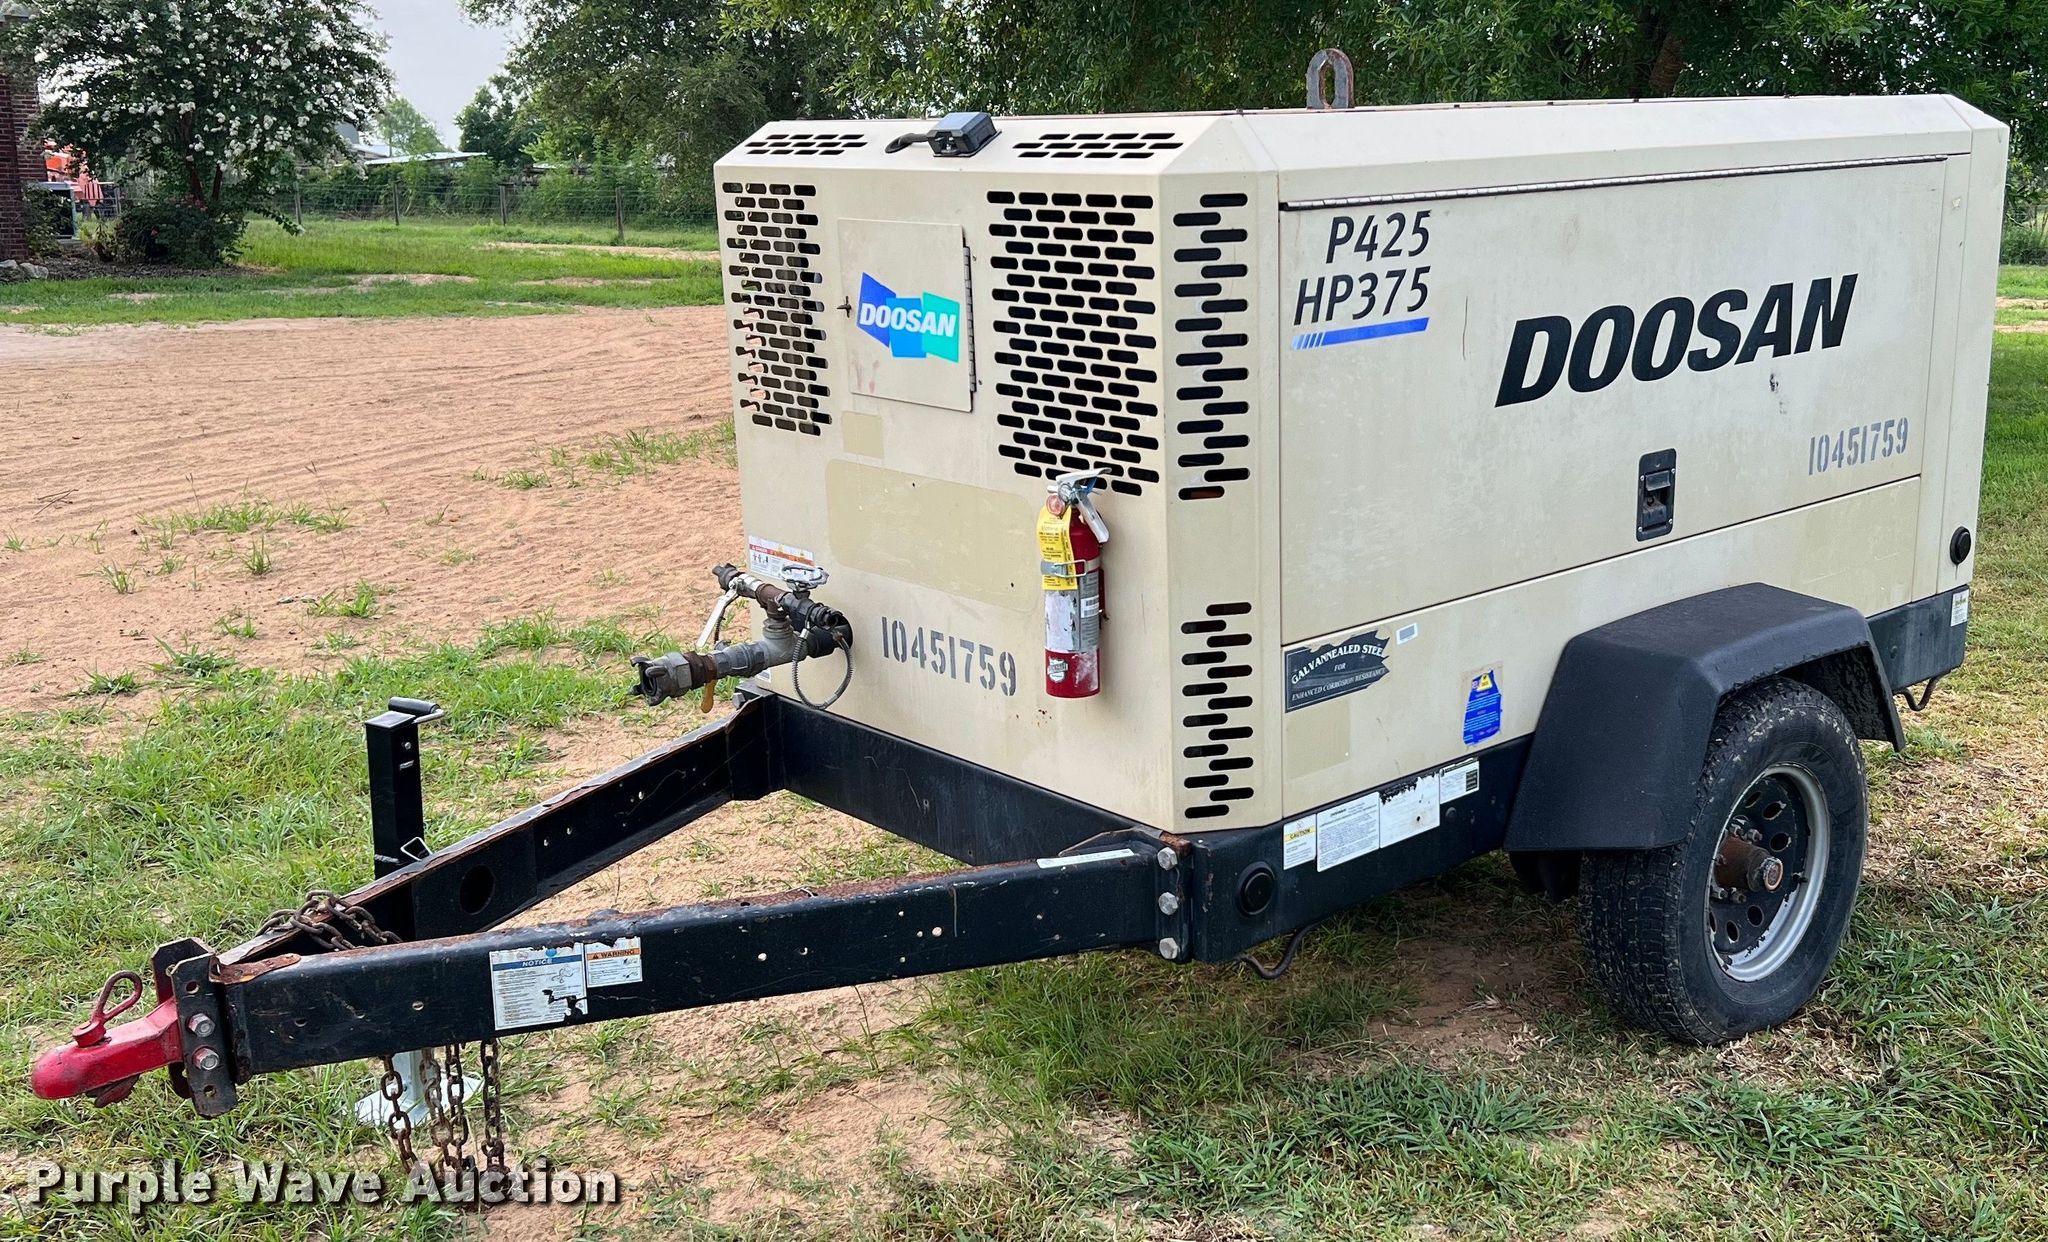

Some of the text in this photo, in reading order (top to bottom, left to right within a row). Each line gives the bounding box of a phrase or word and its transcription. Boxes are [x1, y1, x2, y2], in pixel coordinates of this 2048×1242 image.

[1326, 210, 1432, 264] P425
[1294, 266, 1431, 326] HP375
[859, 302, 957, 338] DOOSAN
[1494, 273, 1858, 408] DOOSAN
[1809, 417, 1909, 476] 10451759
[881, 616, 1017, 697] 10451759
[1291, 644, 1385, 684] GALVANNEALED STEE
[1334, 662, 1346, 672] FOR
[1292, 686, 1322, 700] ENHANCED
[1323, 678, 1354, 691] CORROSION
[522, 958, 553, 967] NOTICE
[600, 949, 635, 959] WARNING
